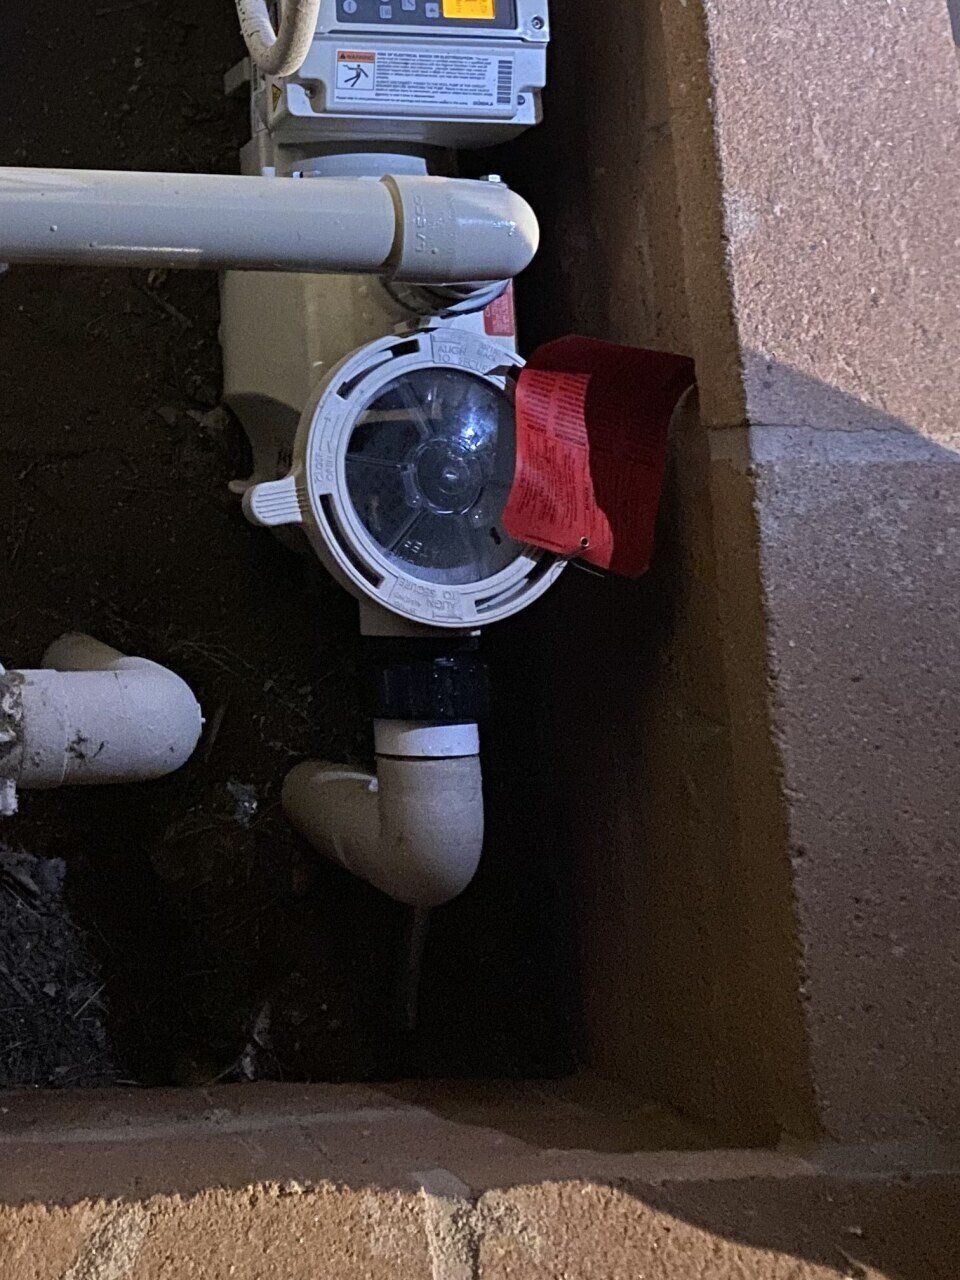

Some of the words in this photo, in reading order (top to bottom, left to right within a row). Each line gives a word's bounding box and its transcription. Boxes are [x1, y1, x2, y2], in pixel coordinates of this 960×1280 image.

[437, 344, 467, 356] ALIGN
[438, 353, 451, 363] TO
[426, 599, 456, 610] ALIGN
